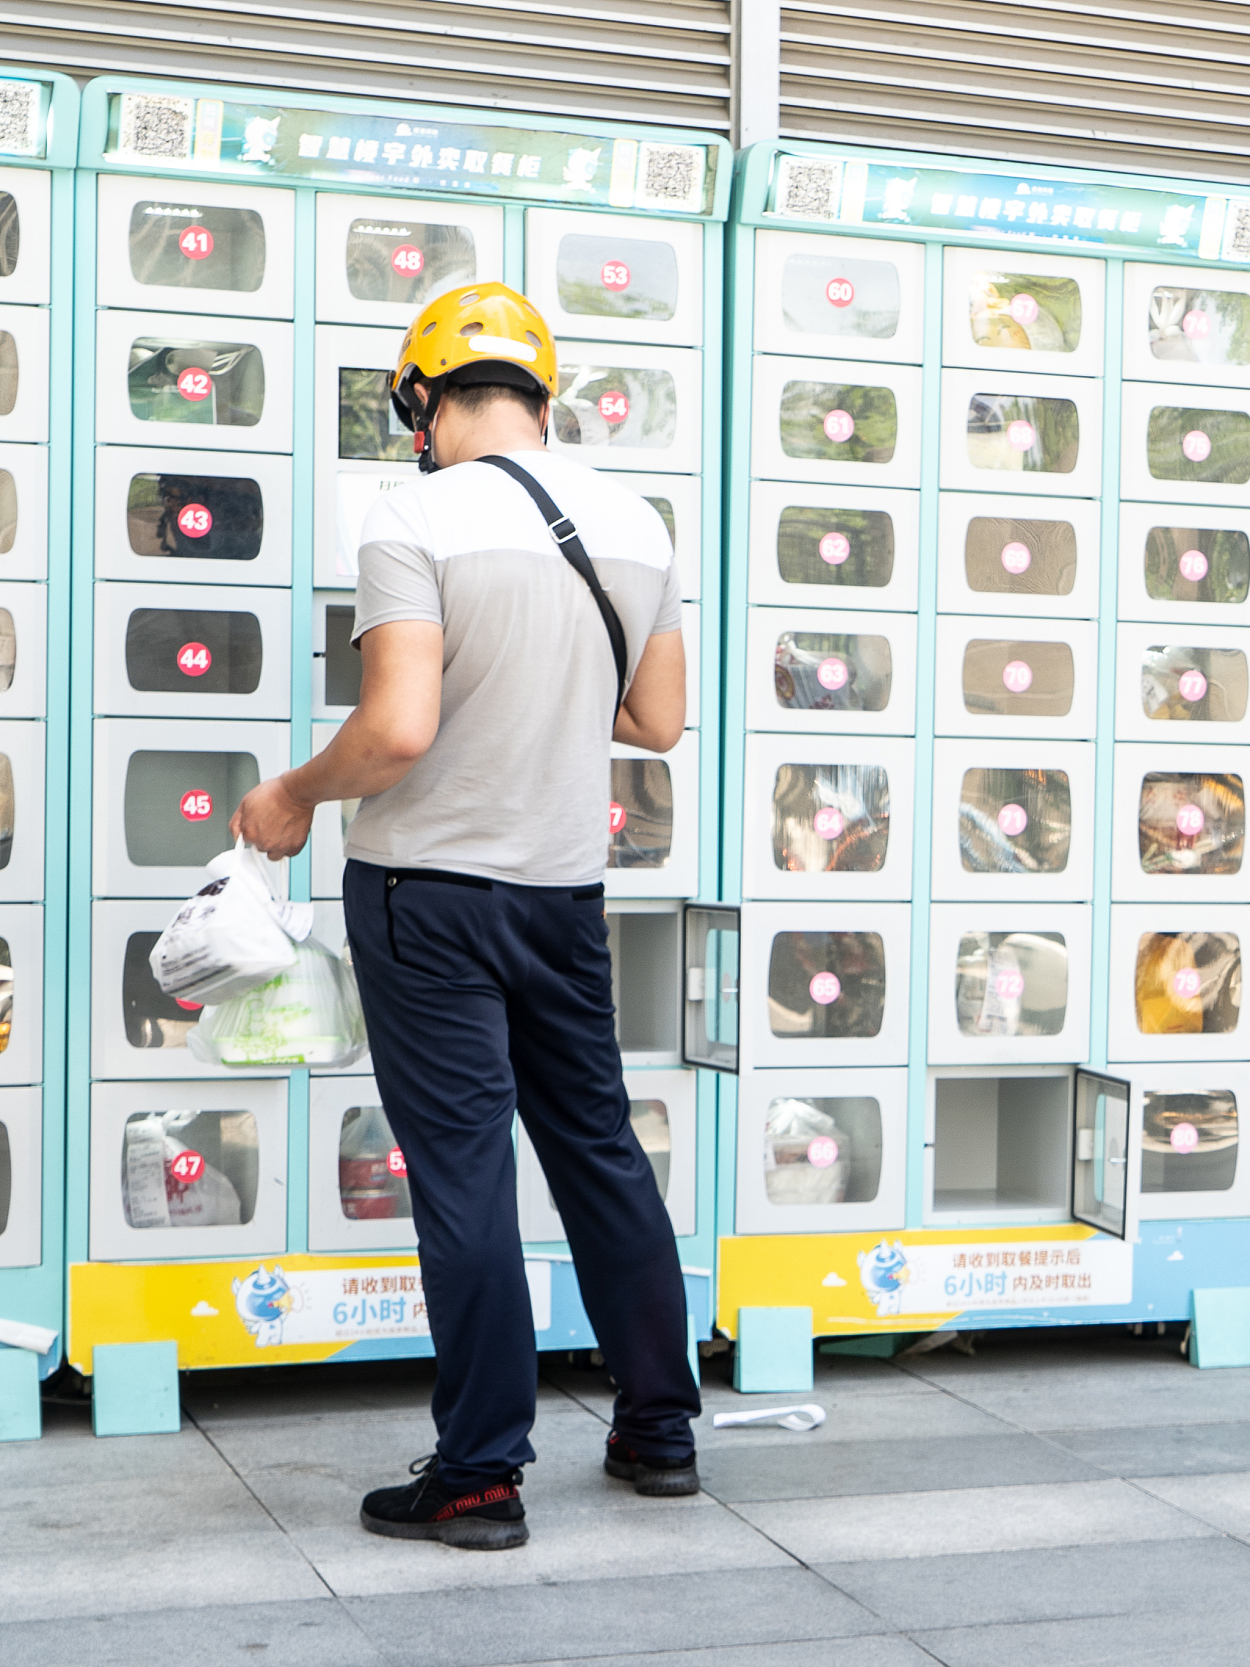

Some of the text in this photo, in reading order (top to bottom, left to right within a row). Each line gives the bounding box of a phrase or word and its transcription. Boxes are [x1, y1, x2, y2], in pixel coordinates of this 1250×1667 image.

[183, 233, 207, 251] 41
[395, 251, 420, 269] 48
[604, 266, 627, 284] 53
[829, 283, 852, 300] 60
[1011, 300, 1034, 317] 67
[1187, 316, 1209, 333] 74
[181, 374, 207, 393] 42
[602, 398, 626, 415] 54
[827, 417, 848, 434] 61
[1010, 427, 1032, 444] 68
[1187, 436, 1207, 454] 75
[182, 511, 208, 530] 43
[823, 539, 845, 556] 62
[1005, 550, 1027, 567] 69
[1183, 557, 1204, 573] 76
[181, 649, 207, 668] 44
[821, 665, 843, 682] 63
[1007, 668, 1029, 684] 70
[1182, 677, 1203, 693] 77
[184, 796, 210, 814] 45
[817, 814, 840, 831] 64
[1002, 810, 1021, 827] 71
[1179, 810, 1201, 827] 78
[813, 979, 836, 996] 65
[998, 975, 1020, 992] 72
[1177, 974, 1197, 991] 79
[1174, 1129, 1195, 1146] 80
[811, 1143, 834, 1160] 66
[175, 1157, 199, 1175] 47
[953, 1248, 1081, 1269] 请收到取餐提示后
[342, 1275, 425, 1296] 请收到取
[943, 1271, 1092, 1297] 6小时 内及时取出
[332, 1297, 407, 1326] 6小时
